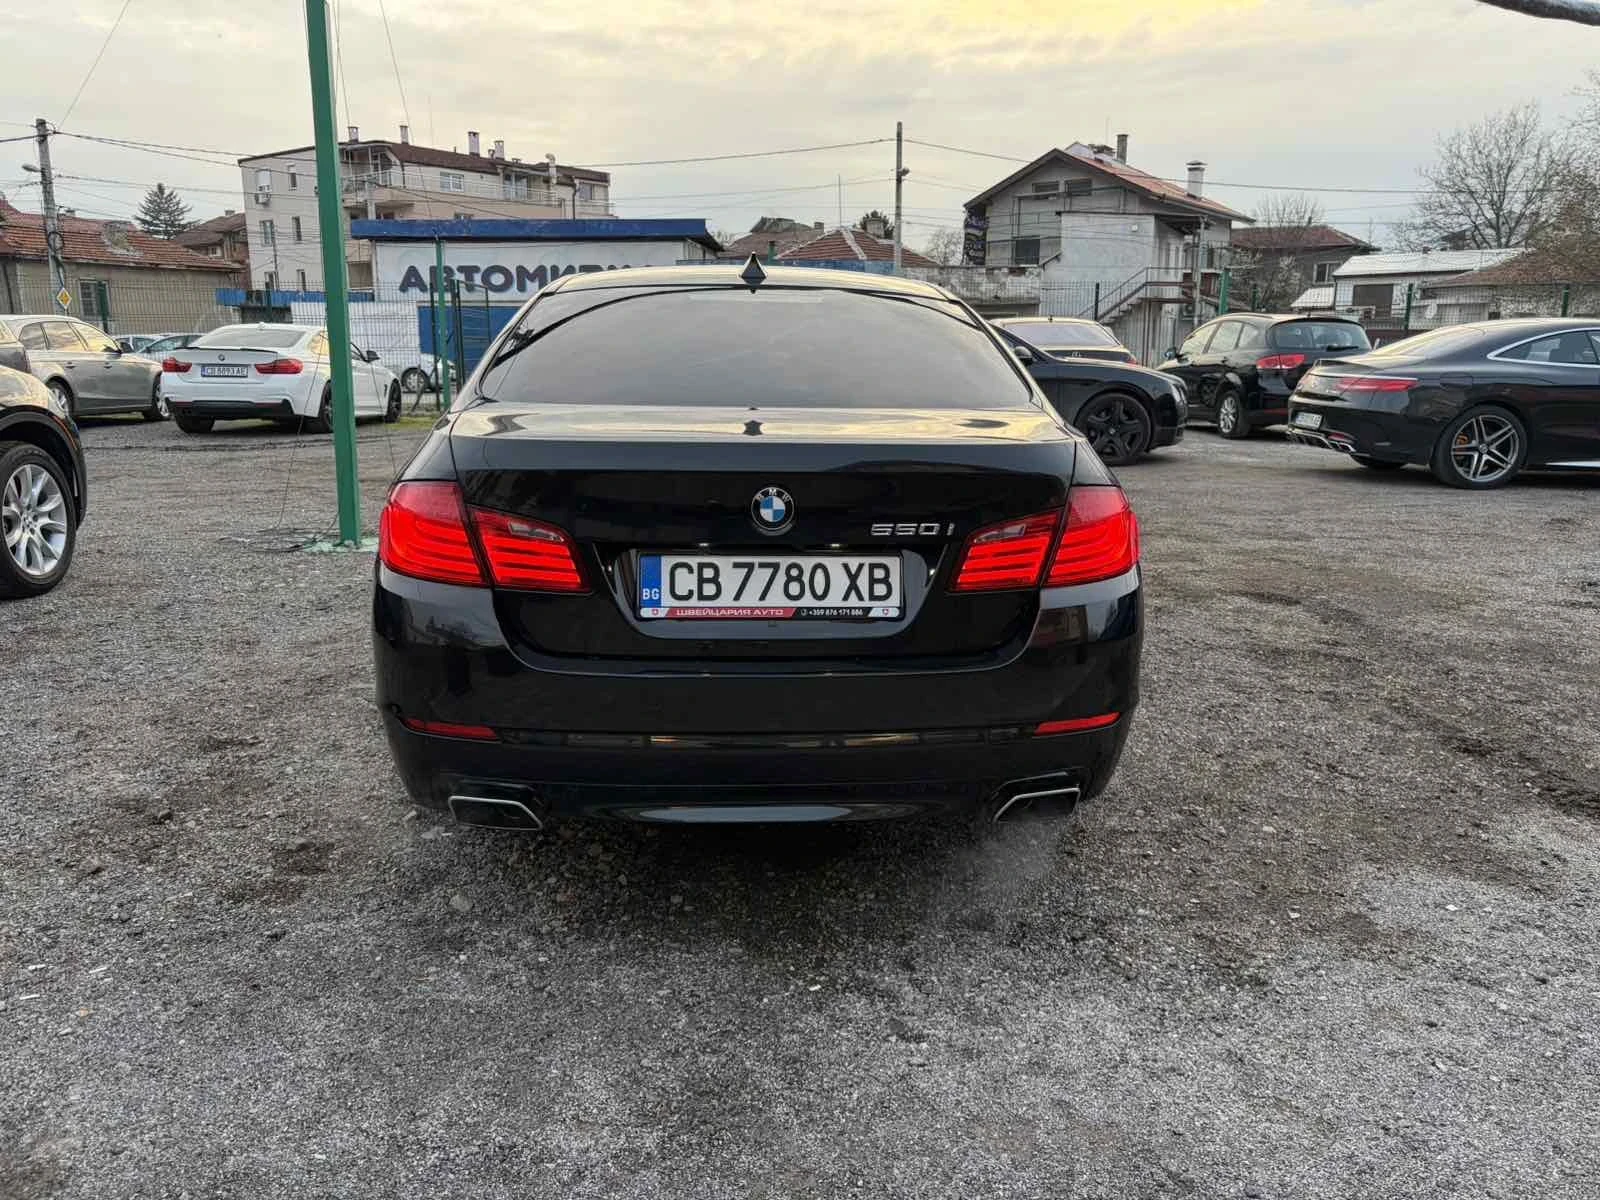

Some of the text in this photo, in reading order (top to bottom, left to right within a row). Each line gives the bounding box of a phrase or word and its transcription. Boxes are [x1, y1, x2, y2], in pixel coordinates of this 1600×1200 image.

[399, 264, 653, 293] АВТОМ
[669, 561, 893, 602] CB 7780 XB
[642, 588, 660, 600] BG
[676, 607, 751, 617] ШВЕЙЦАРИЯ
